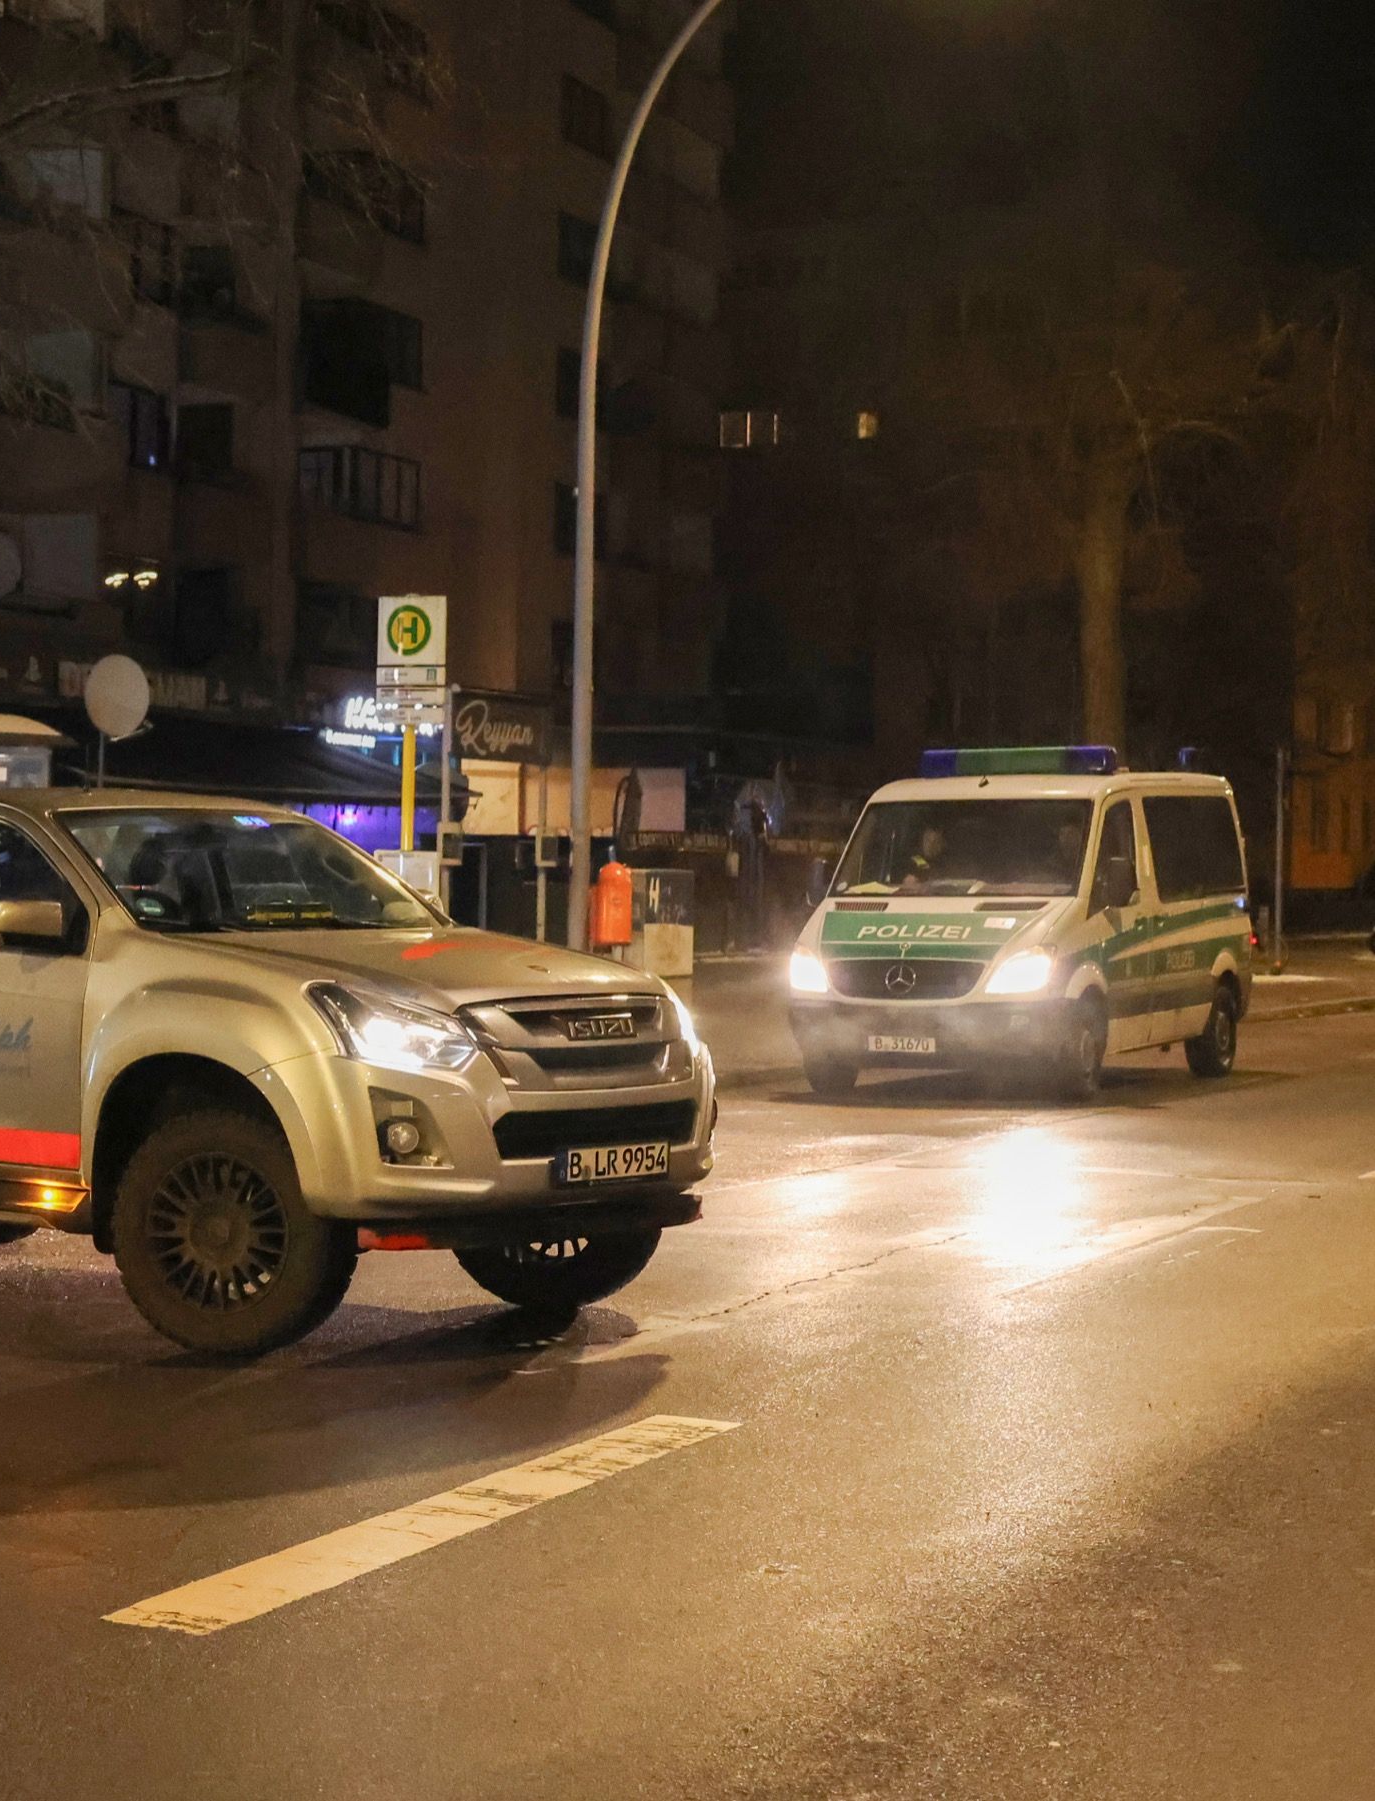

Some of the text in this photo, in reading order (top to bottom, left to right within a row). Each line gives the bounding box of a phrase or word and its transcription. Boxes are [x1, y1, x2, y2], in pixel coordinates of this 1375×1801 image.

[397, 616, 418, 644] H
[857, 924, 972, 939] POLIZEI
[568, 1019, 634, 1039] ISUZU
[569, 1145, 666, 1179] B LR 9954
